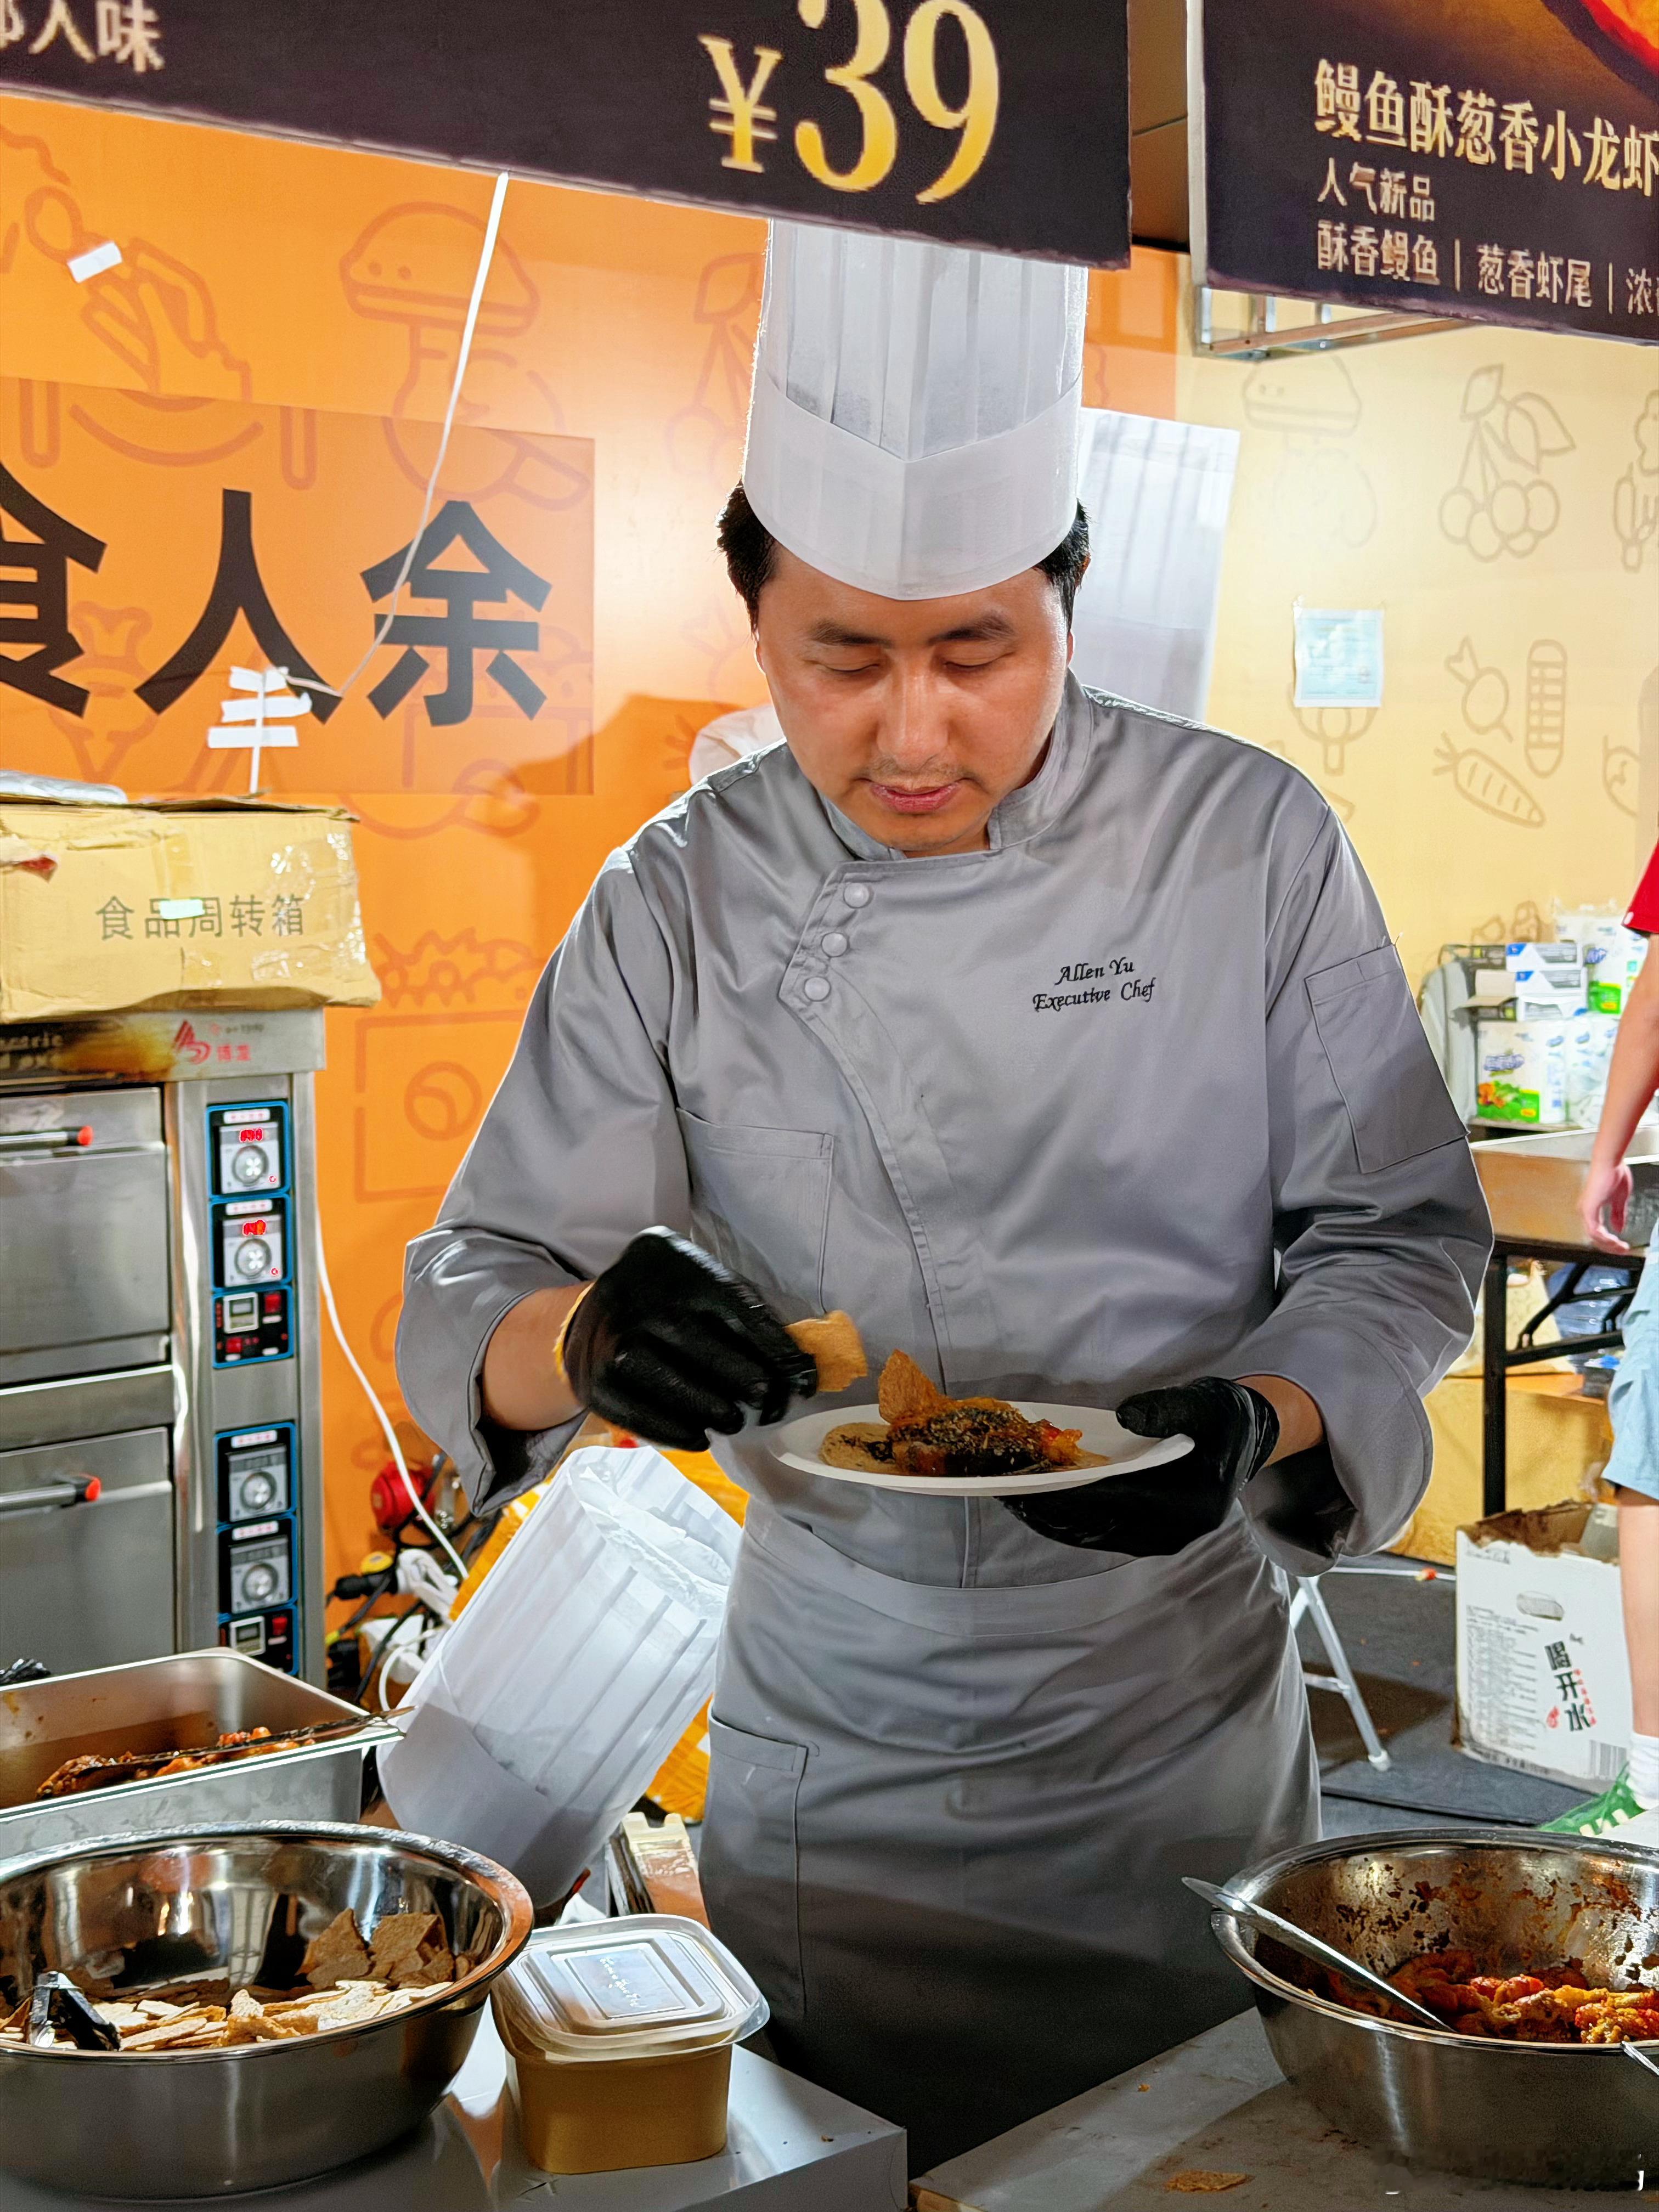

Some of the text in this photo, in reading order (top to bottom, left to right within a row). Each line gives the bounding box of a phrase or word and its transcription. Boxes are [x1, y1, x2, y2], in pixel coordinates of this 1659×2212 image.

[697, 0, 1000, 205] ¥39
[1314, 58, 1659, 196] 鳗鱼酥葱香小龙虾
[1317, 157, 1435, 222] 人气新品
[1317, 219, 1659, 316] 酥香鳗鱼 葱香虾尾 浓
[95, 894, 304, 941] 食品周转箱
[1032, 977, 1157, 1012] Executive Chef
[1054, 956, 1135, 986] Allen Yu
